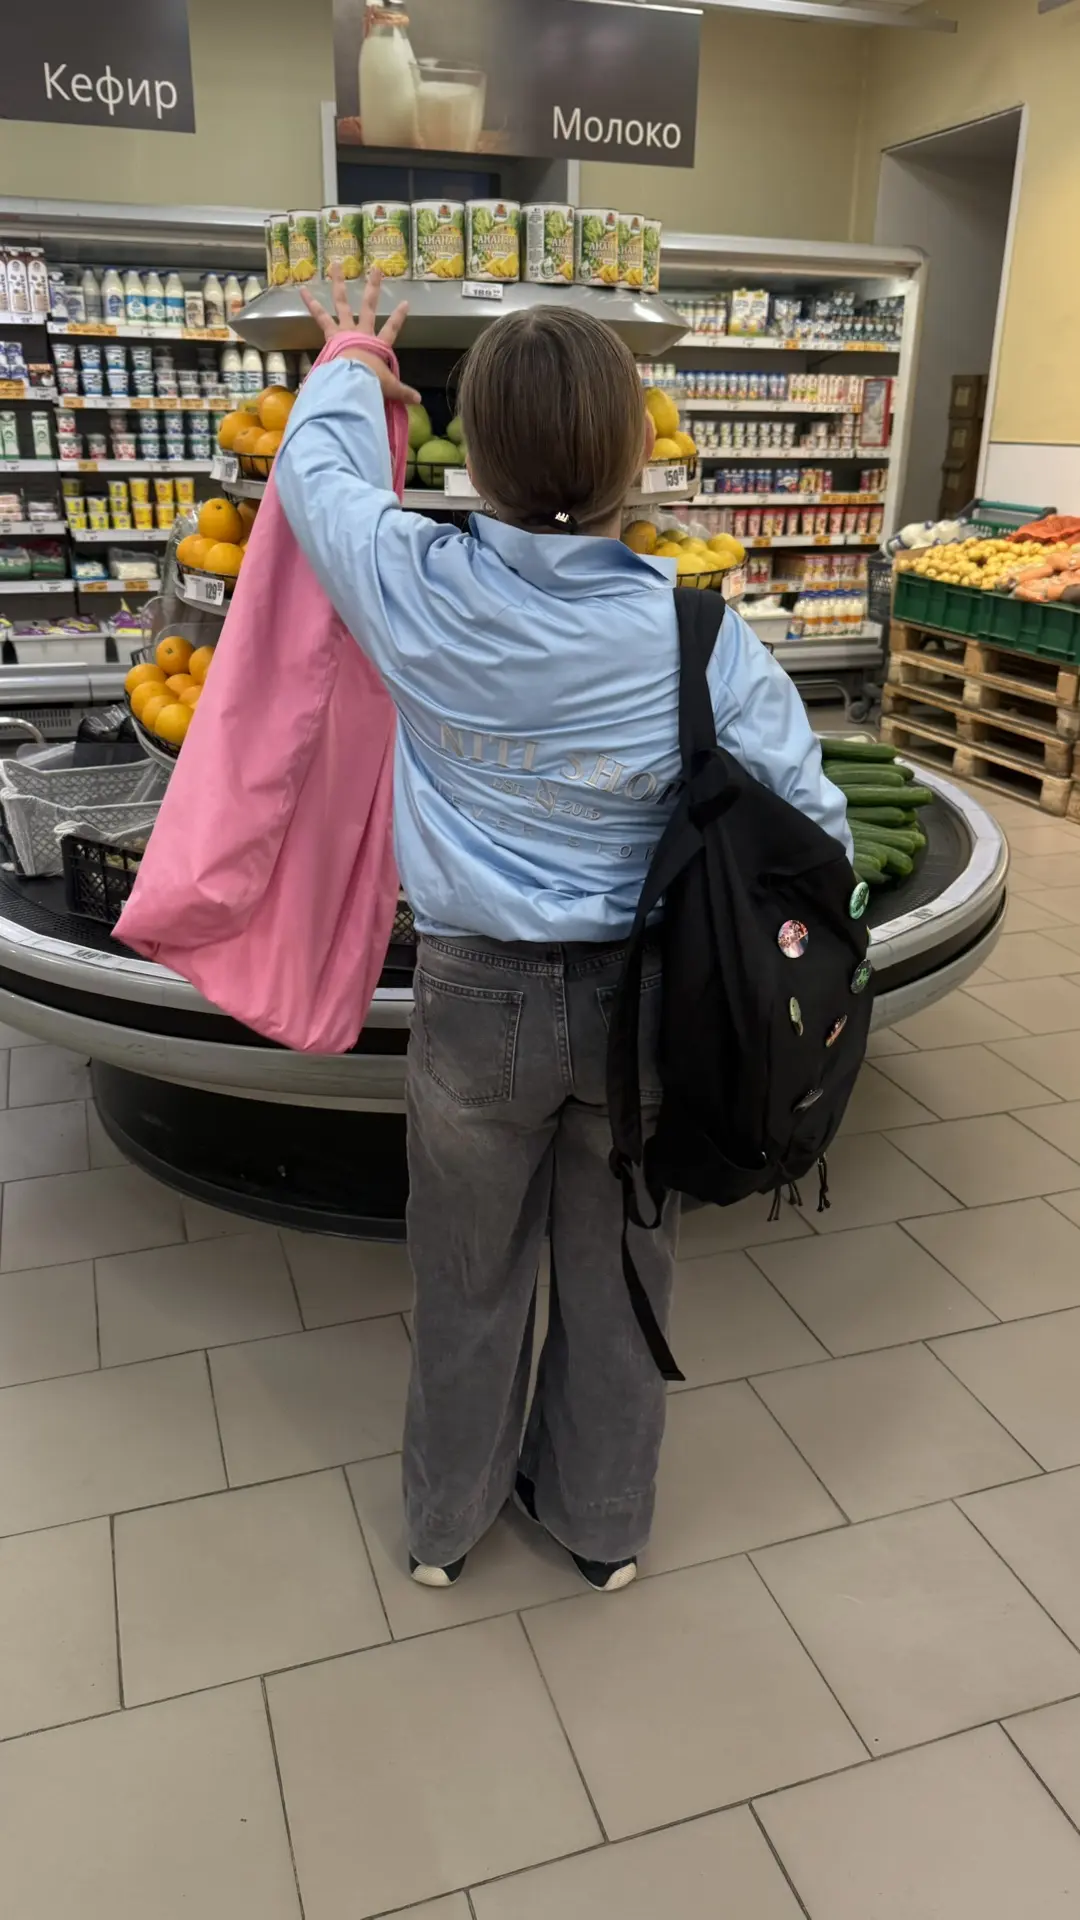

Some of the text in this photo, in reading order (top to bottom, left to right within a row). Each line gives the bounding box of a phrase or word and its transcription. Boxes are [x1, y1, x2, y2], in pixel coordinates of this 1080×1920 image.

[43, 61, 178, 120] Кефир
[552, 105, 682, 149] Молоко
[664, 469, 679, 487] 159
[205, 582, 217, 600] 129
[437, 720, 541, 773] NITI
[560, 799, 601, 821] 2015
